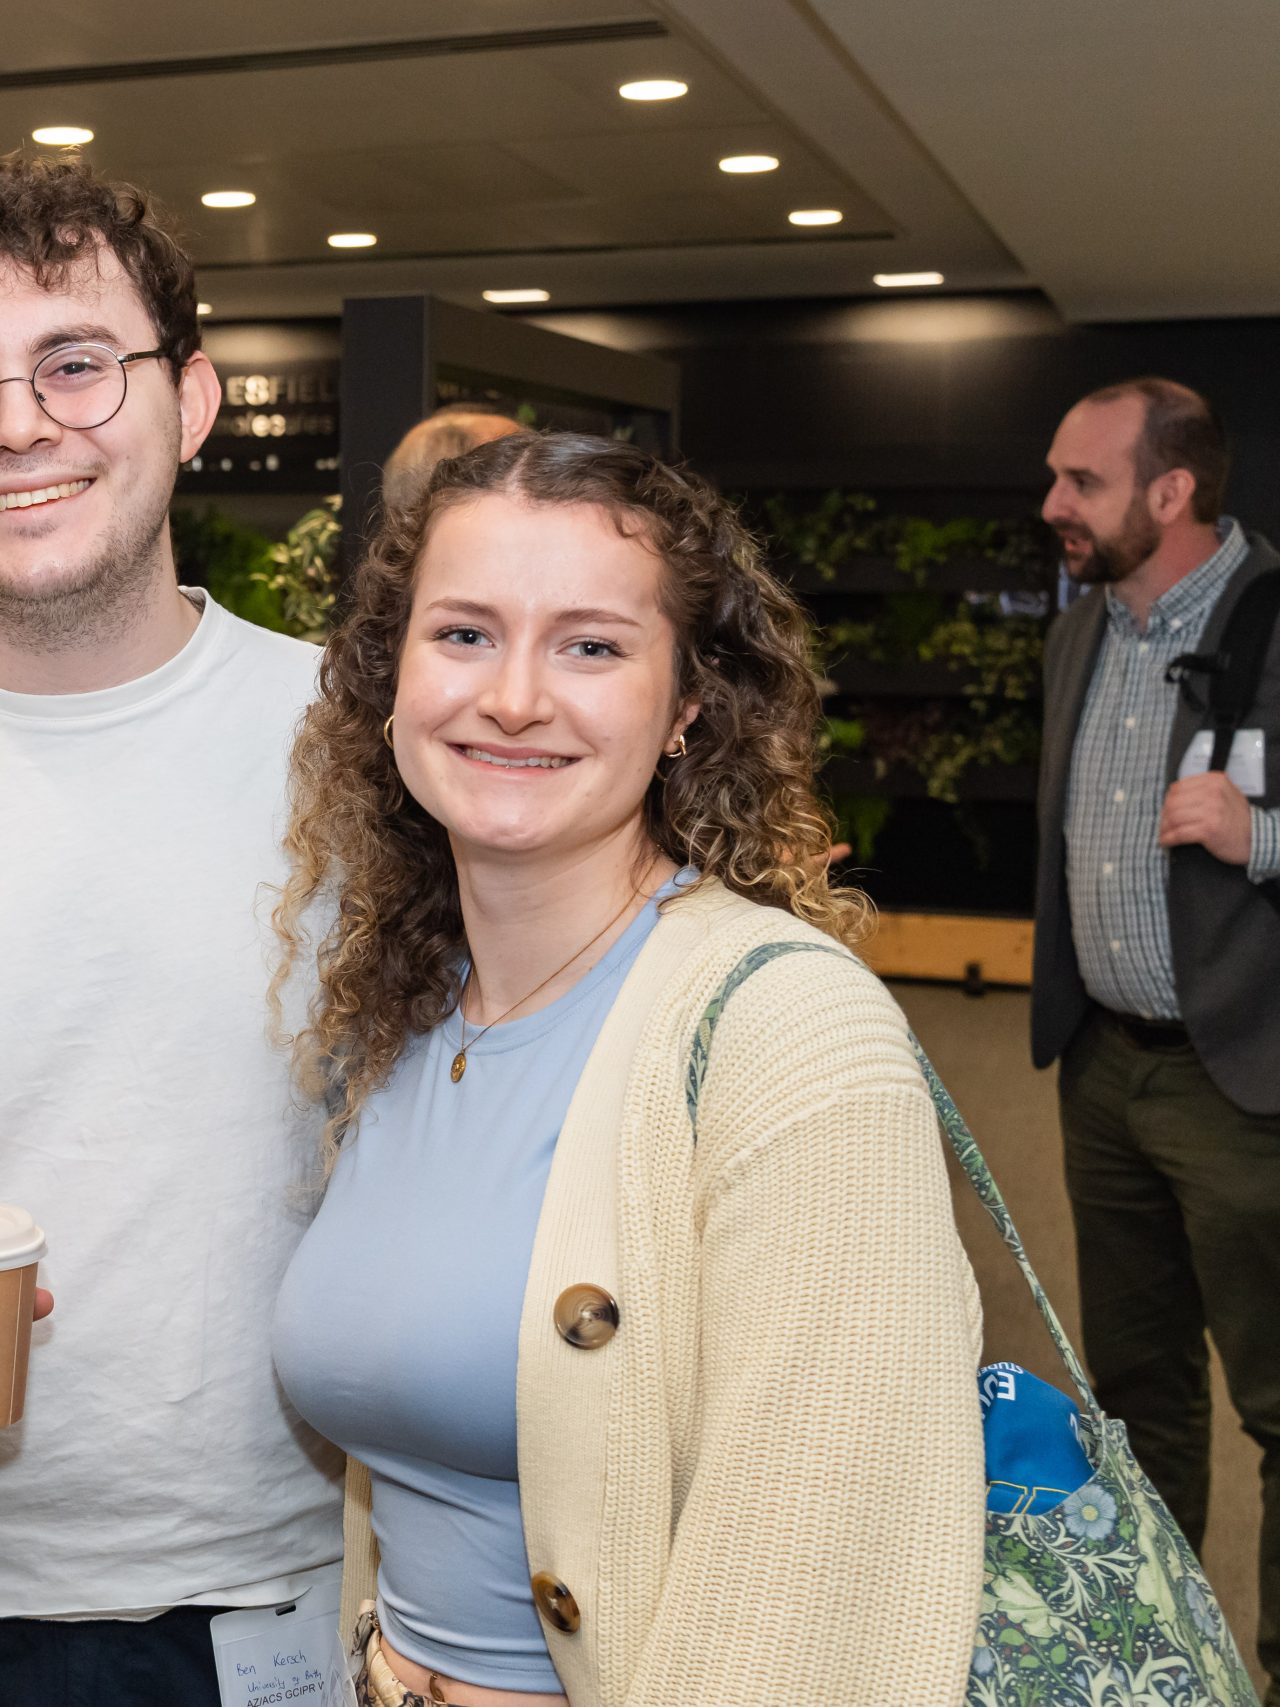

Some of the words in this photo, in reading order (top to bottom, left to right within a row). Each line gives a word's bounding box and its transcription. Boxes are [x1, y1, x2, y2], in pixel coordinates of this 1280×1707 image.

[237, 1663, 256, 1676] Ben
[248, 1677, 285, 1692] University
[247, 1692, 283, 1707] AZ/ACS
[285, 1683, 316, 1698] GCIPR
